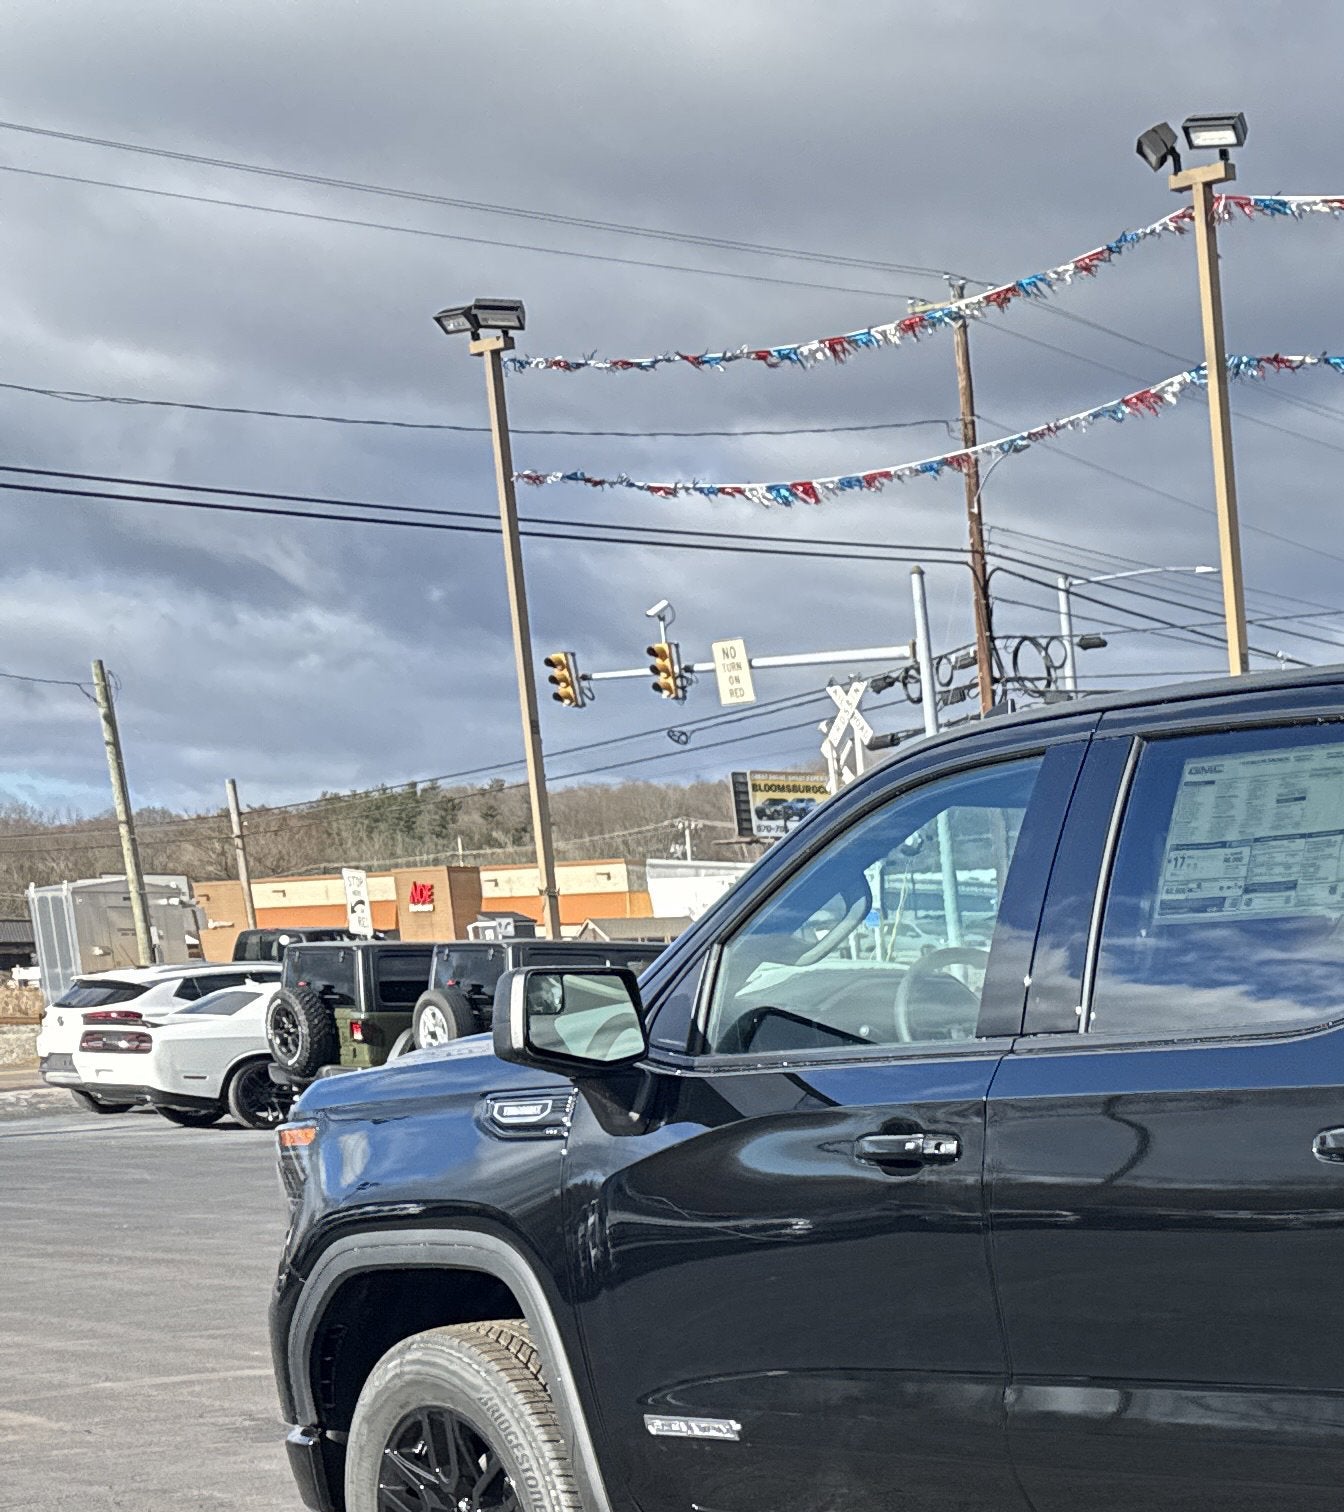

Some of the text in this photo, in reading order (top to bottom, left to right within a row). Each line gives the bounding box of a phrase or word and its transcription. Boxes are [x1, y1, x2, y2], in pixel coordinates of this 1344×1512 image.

[721, 645, 737, 660] NO
[721, 661, 743, 672] TURN
[728, 674, 741, 686] ON
[728, 687, 745, 698] RED
[409, 881, 434, 904] ACE
